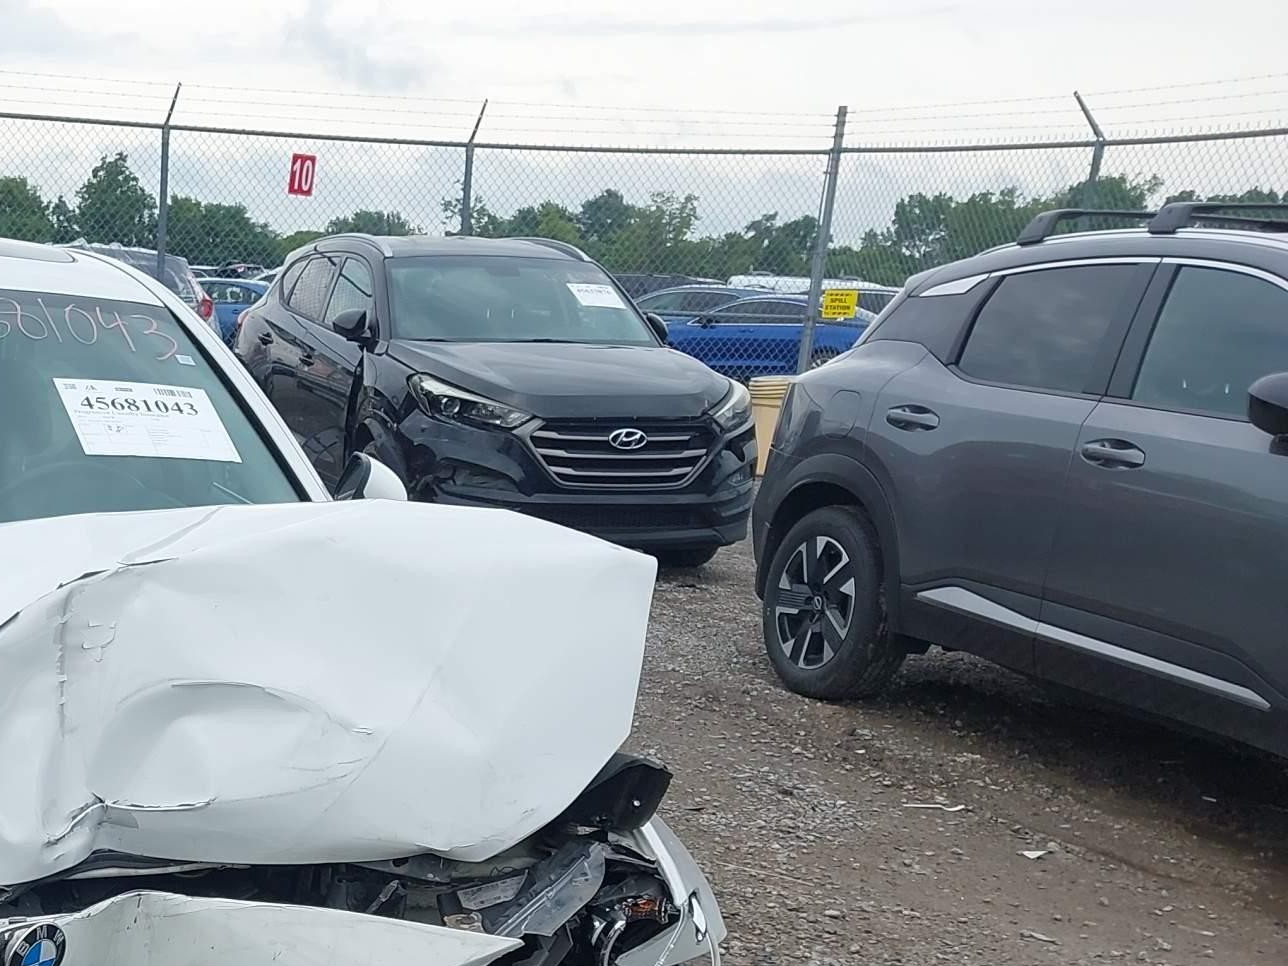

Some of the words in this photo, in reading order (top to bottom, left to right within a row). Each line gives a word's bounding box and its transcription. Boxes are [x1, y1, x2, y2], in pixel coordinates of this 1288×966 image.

[293, 158, 312, 191] 10
[80, 396, 199, 416] 45681043
[16, 925, 65, 957] BMW
